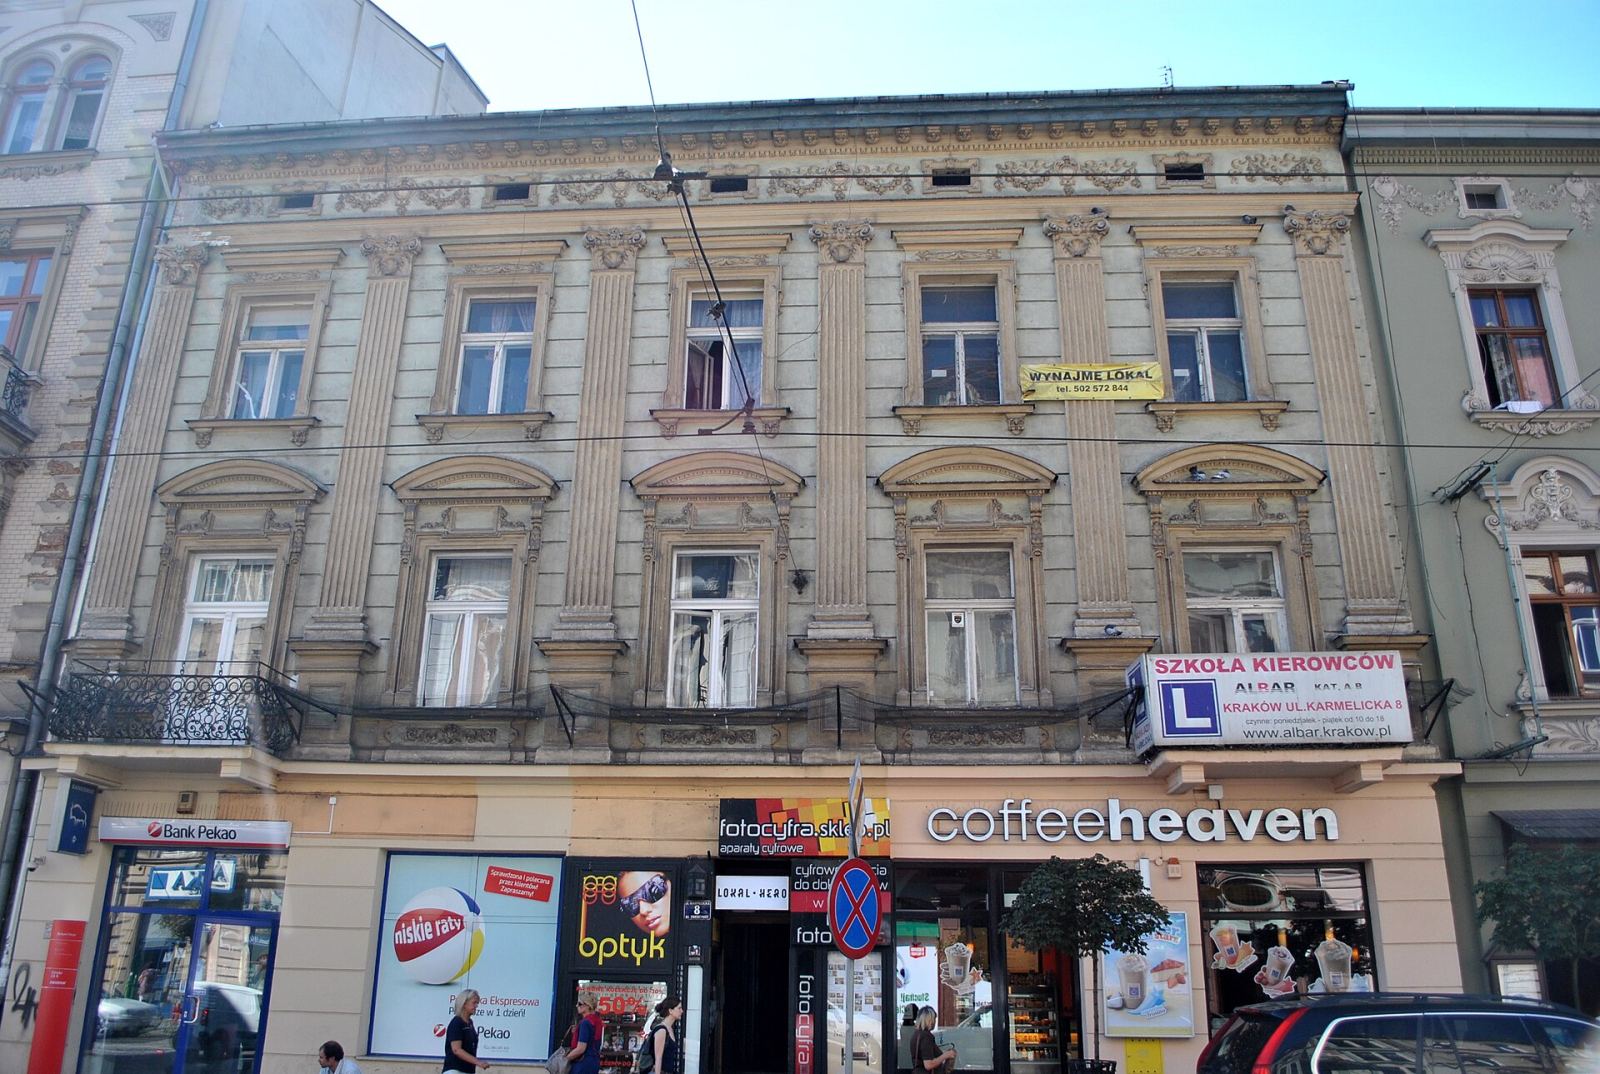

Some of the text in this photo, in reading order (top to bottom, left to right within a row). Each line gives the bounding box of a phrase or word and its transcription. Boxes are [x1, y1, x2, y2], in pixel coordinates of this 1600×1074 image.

[1029, 370, 1153, 381] WYNAJME LOKAL
[1056, 385, 1071, 393] tel.
[1154, 652, 1395, 674] SZKOŁA KIEROWCÓW
[1171, 687, 1212, 729] L
[1223, 701, 1282, 713] KRAKÓW
[1395, 699, 1403, 710] 8
[1243, 725, 1391, 740] www.albar.krakow.pl
[164, 824, 237, 840] Bank Pekao
[720, 818, 890, 842] fotocyfra.skle.pl
[720, 843, 804, 855] aparaty cyfrowe
[490, 869, 523, 880] Sprawdzona
[794, 878, 809, 890] do
[717, 887, 787, 899] LOKAL HERO
[693, 904, 701, 915] 8
[812, 899, 824, 909] w
[395, 915, 462, 945] niskie raty
[578, 930, 666, 966] optyk
[489, 995, 540, 1007] Ekspresowa
[599, 995, 648, 1016] 50%
[496, 1008, 501, 1017] 1
[503, 1008, 527, 1018] dzień!
[477, 1025, 512, 1039] Pekao
